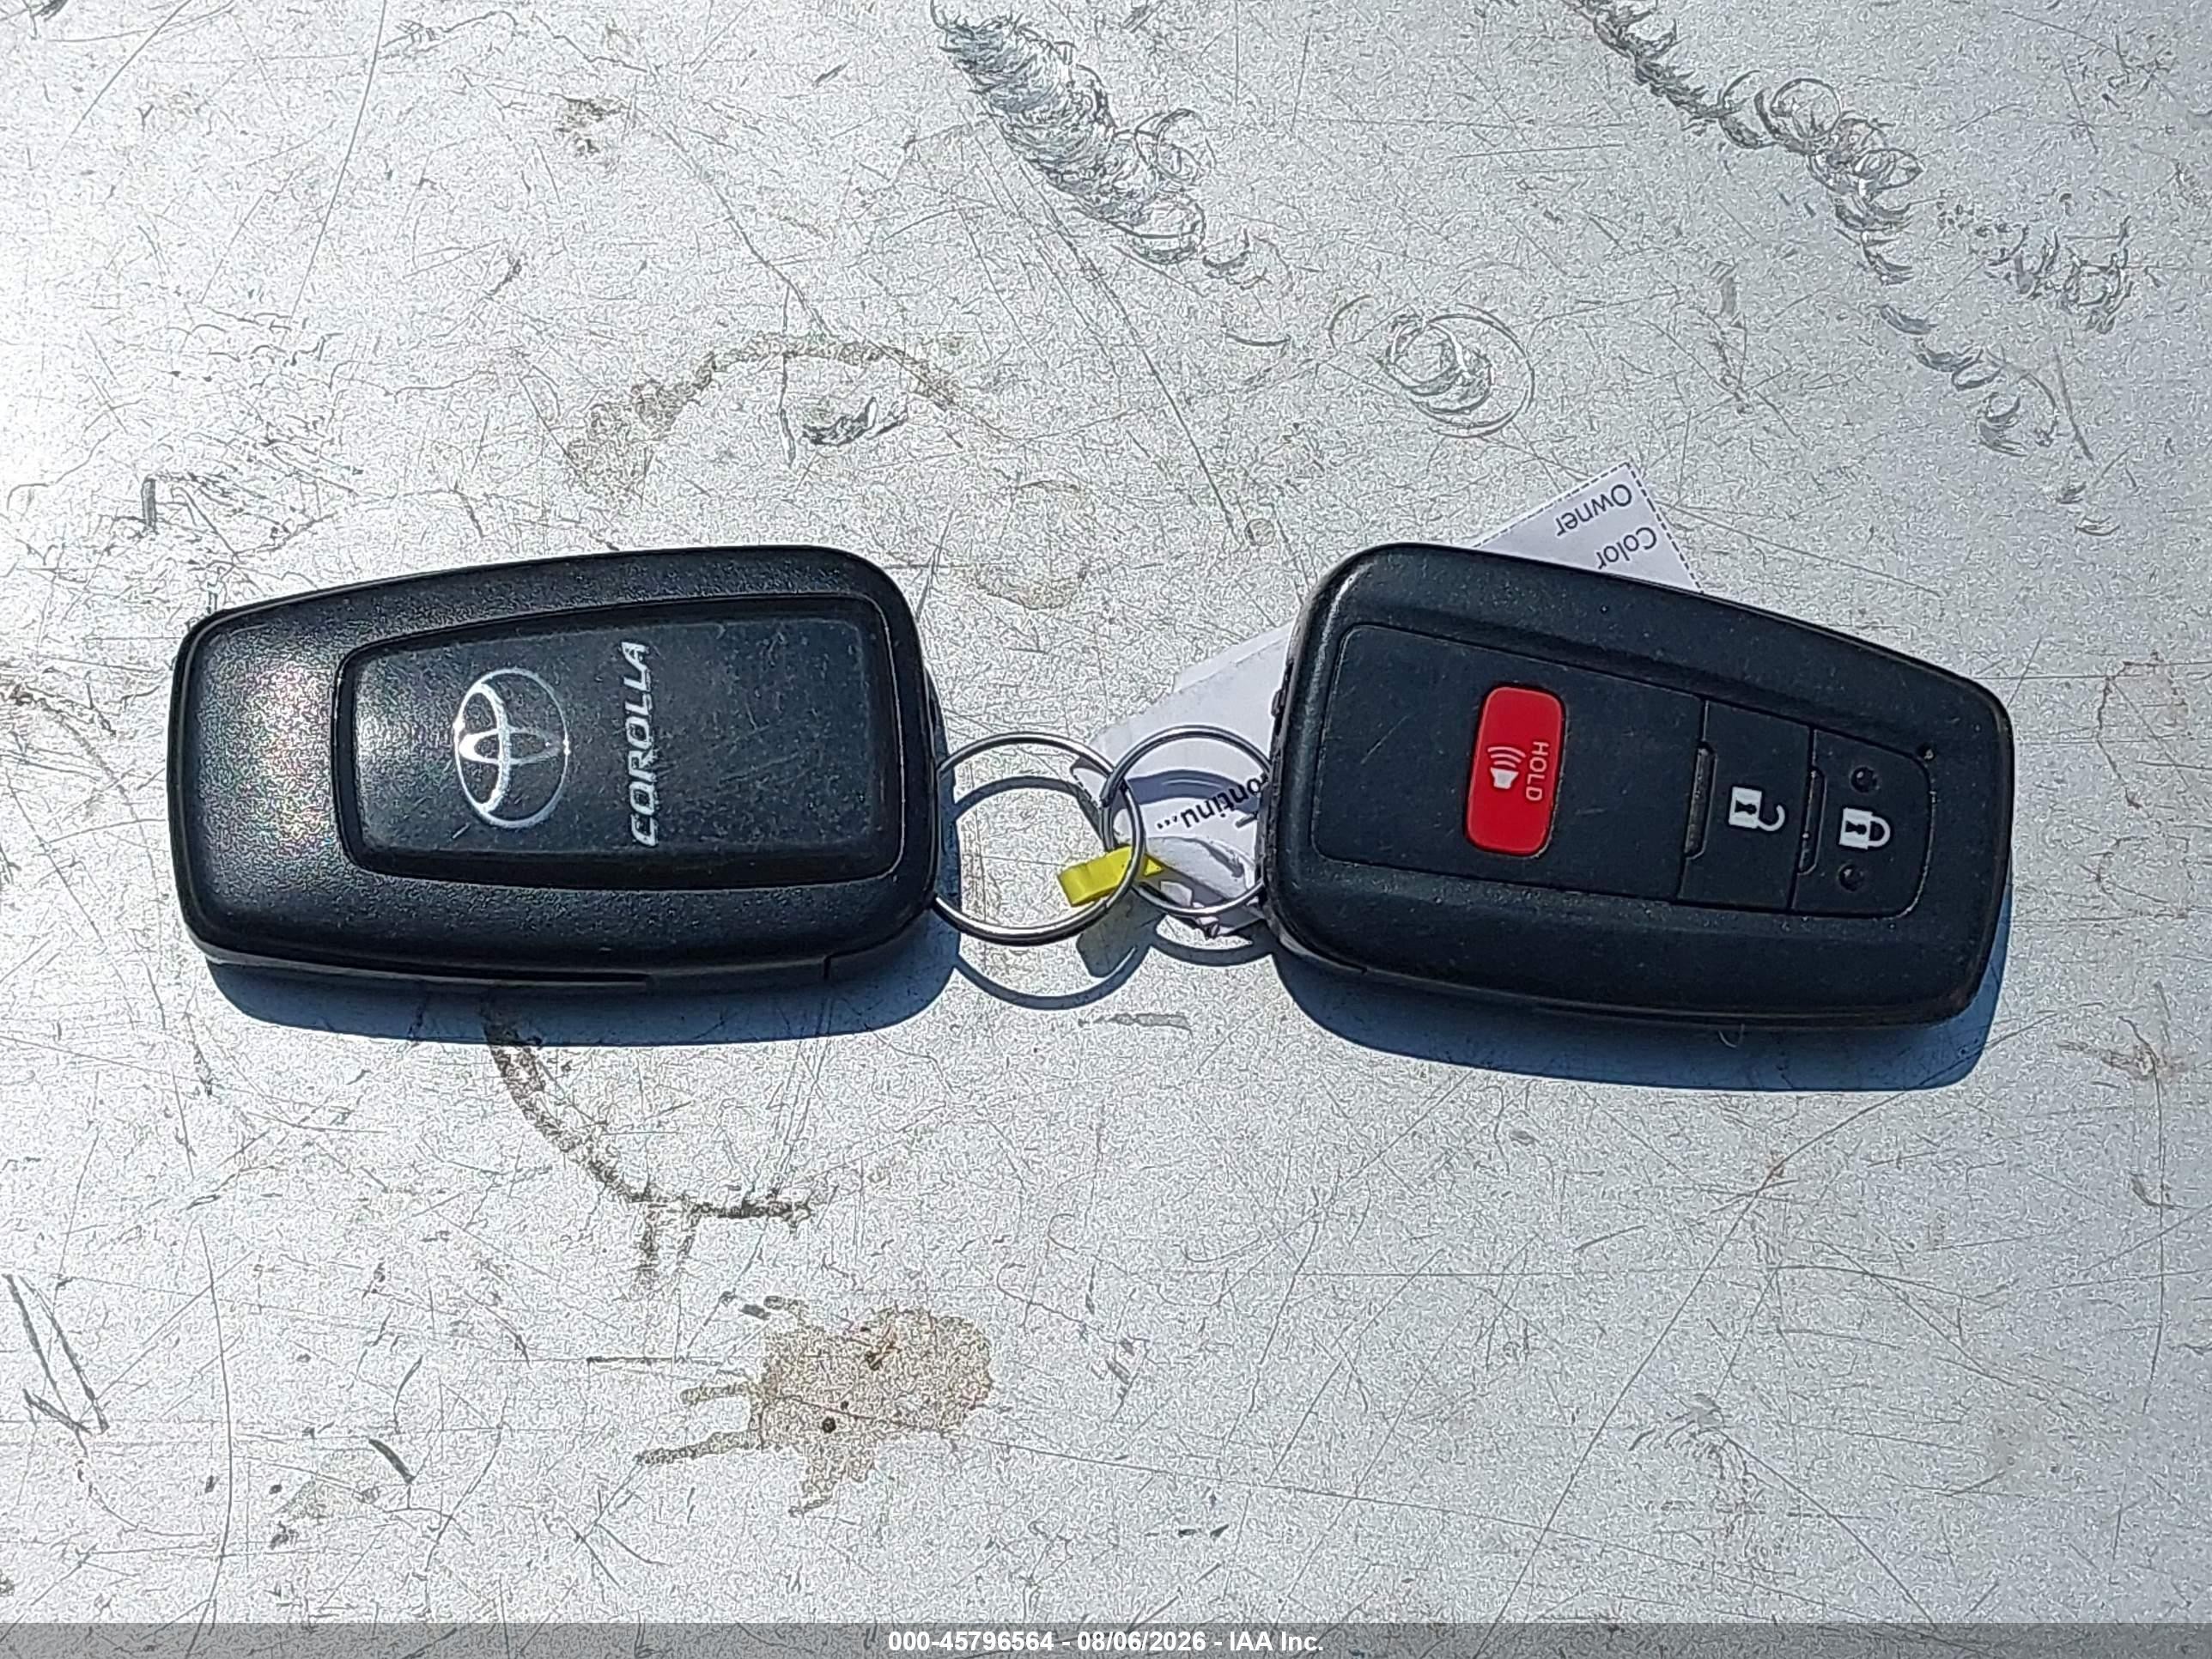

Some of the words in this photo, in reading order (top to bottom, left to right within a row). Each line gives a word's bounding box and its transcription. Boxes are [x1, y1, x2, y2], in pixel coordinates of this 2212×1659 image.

[1555, 484, 1632, 537] Owner
[1595, 527, 1656, 569] Color
[621, 641, 658, 847] COROLLA
[1525, 741, 1549, 801] HOLD
